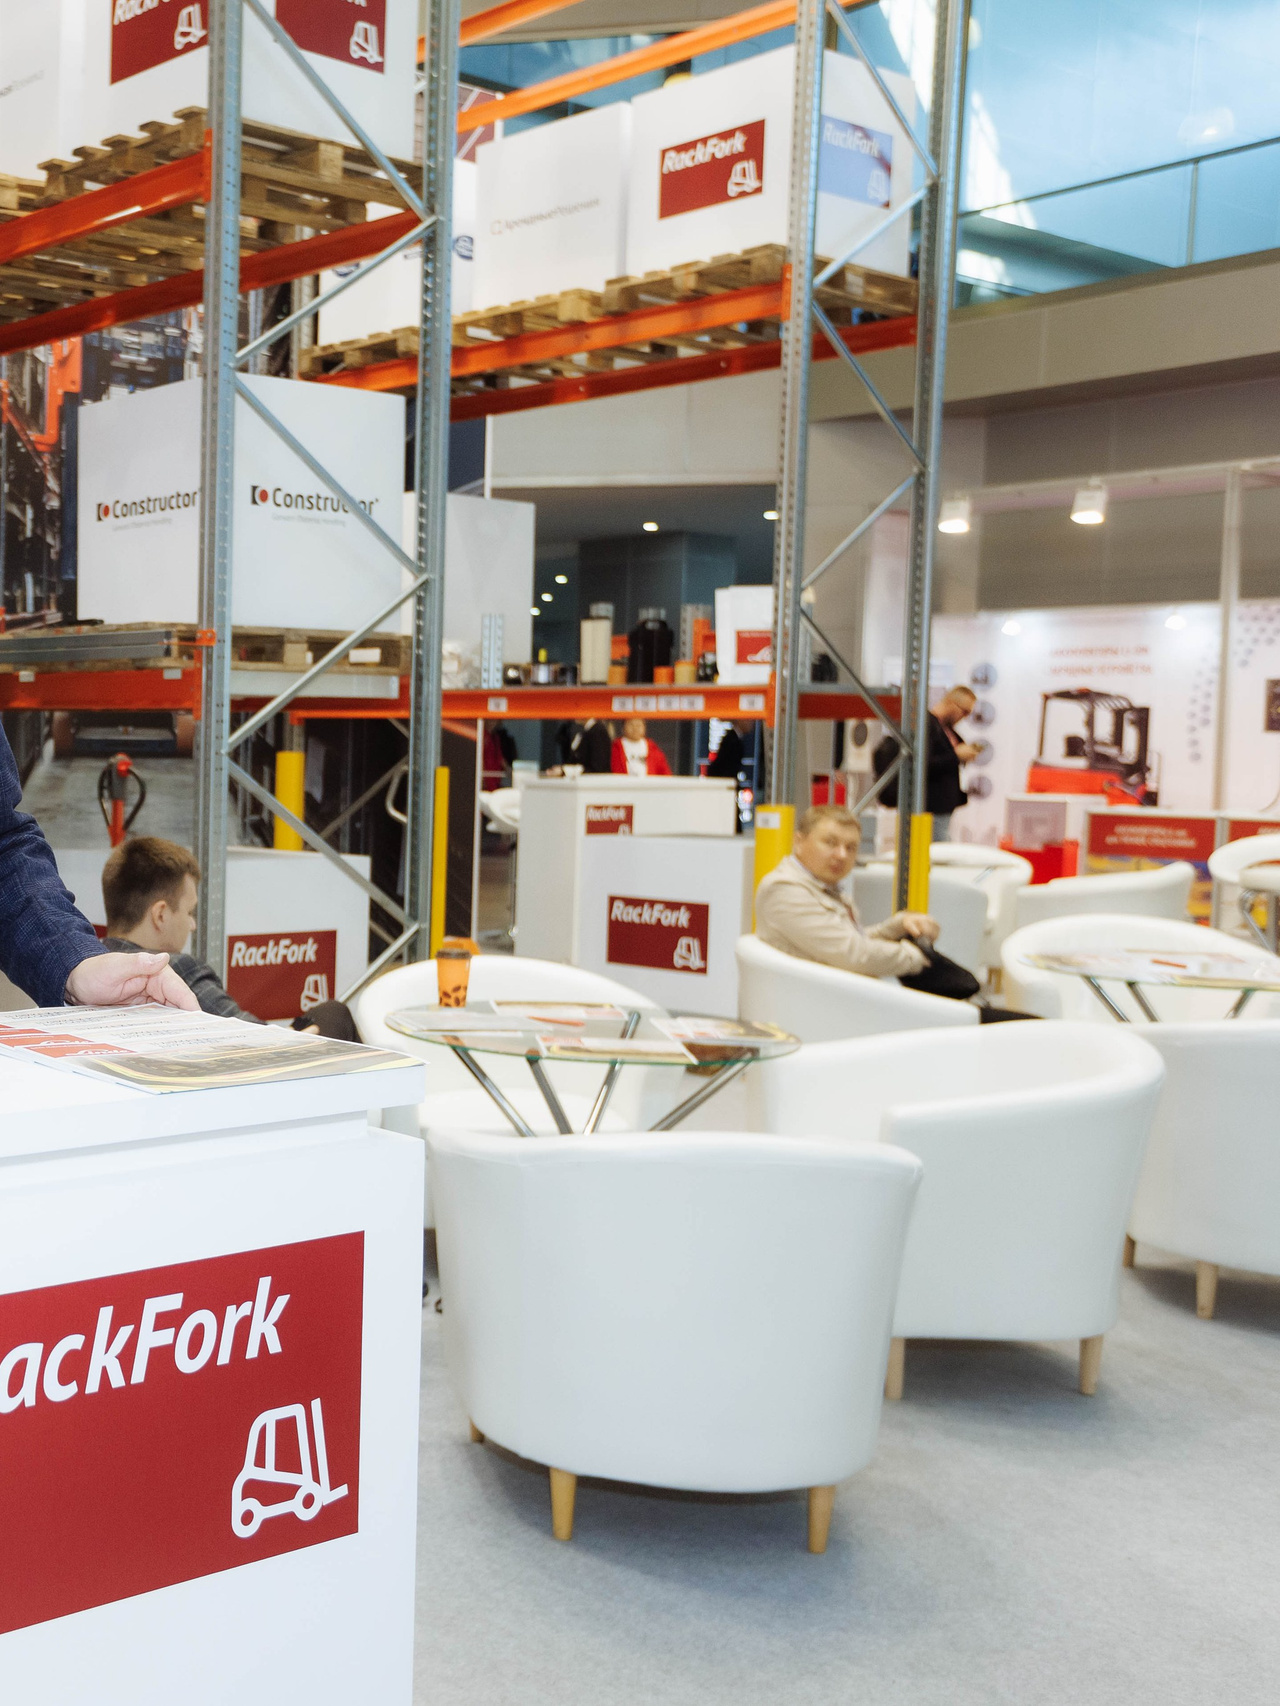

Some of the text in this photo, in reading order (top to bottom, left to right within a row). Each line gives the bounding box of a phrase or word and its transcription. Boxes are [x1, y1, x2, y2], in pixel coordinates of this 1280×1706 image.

[662, 131, 748, 174] RackFork
[823, 121, 881, 159] RackFork
[112, 490, 198, 519] Constructor
[272, 487, 375, 516] Construcor
[611, 899, 691, 929] RackFork
[230, 937, 318, 968] RackFork
